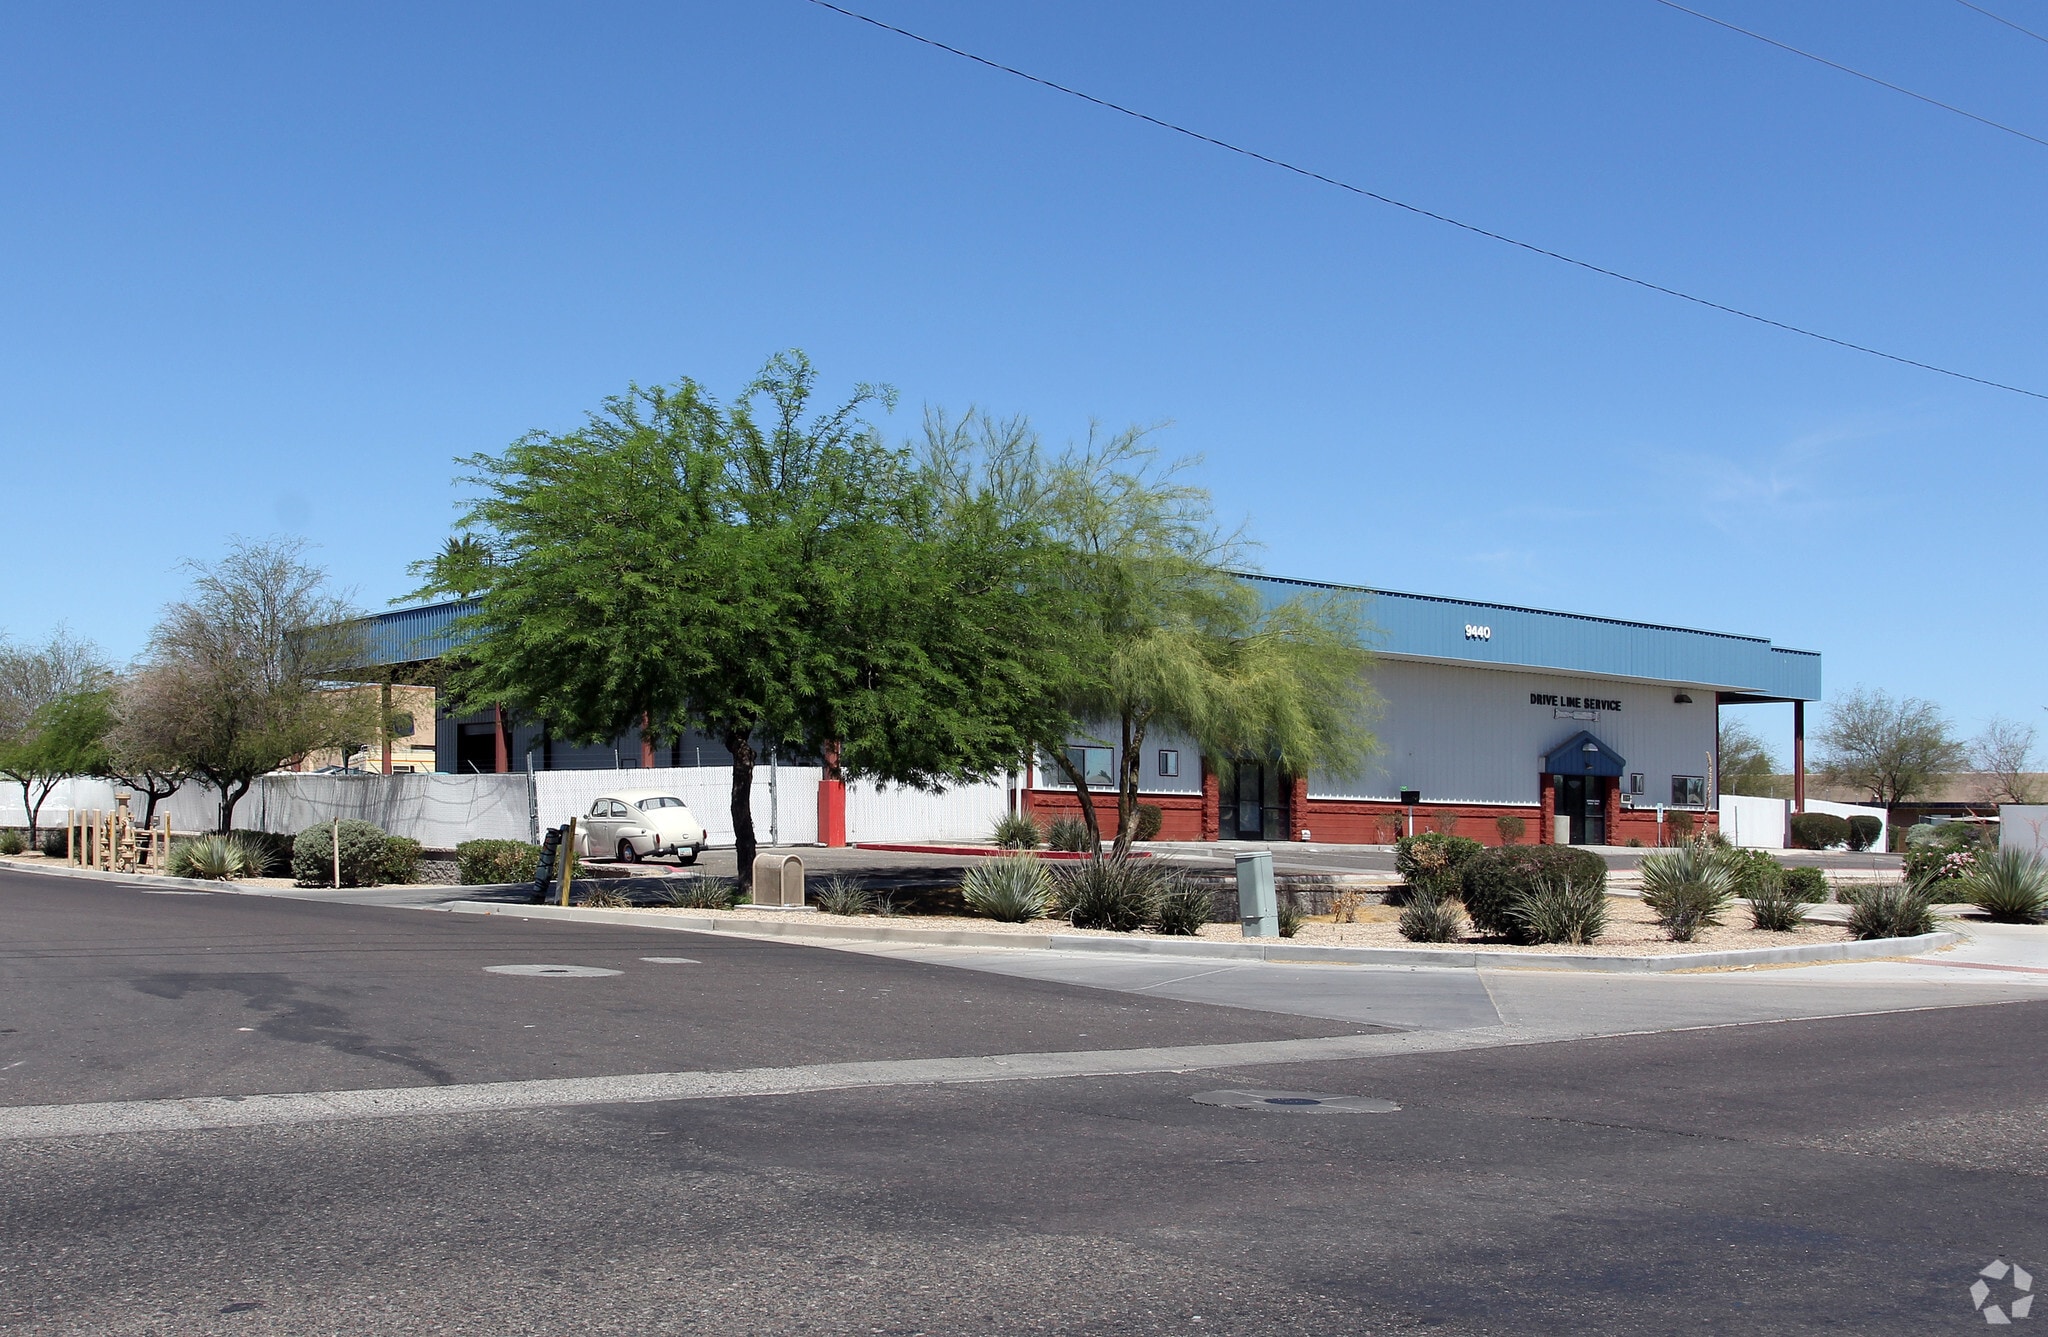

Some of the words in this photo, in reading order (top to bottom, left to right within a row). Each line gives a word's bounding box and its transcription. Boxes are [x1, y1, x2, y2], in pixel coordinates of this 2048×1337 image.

[1465, 624, 1491, 639] 9440
[1530, 693, 1558, 706] DRIVE
[1560, 696, 1581, 708] LINE
[1584, 698, 1621, 711] SERVICE
